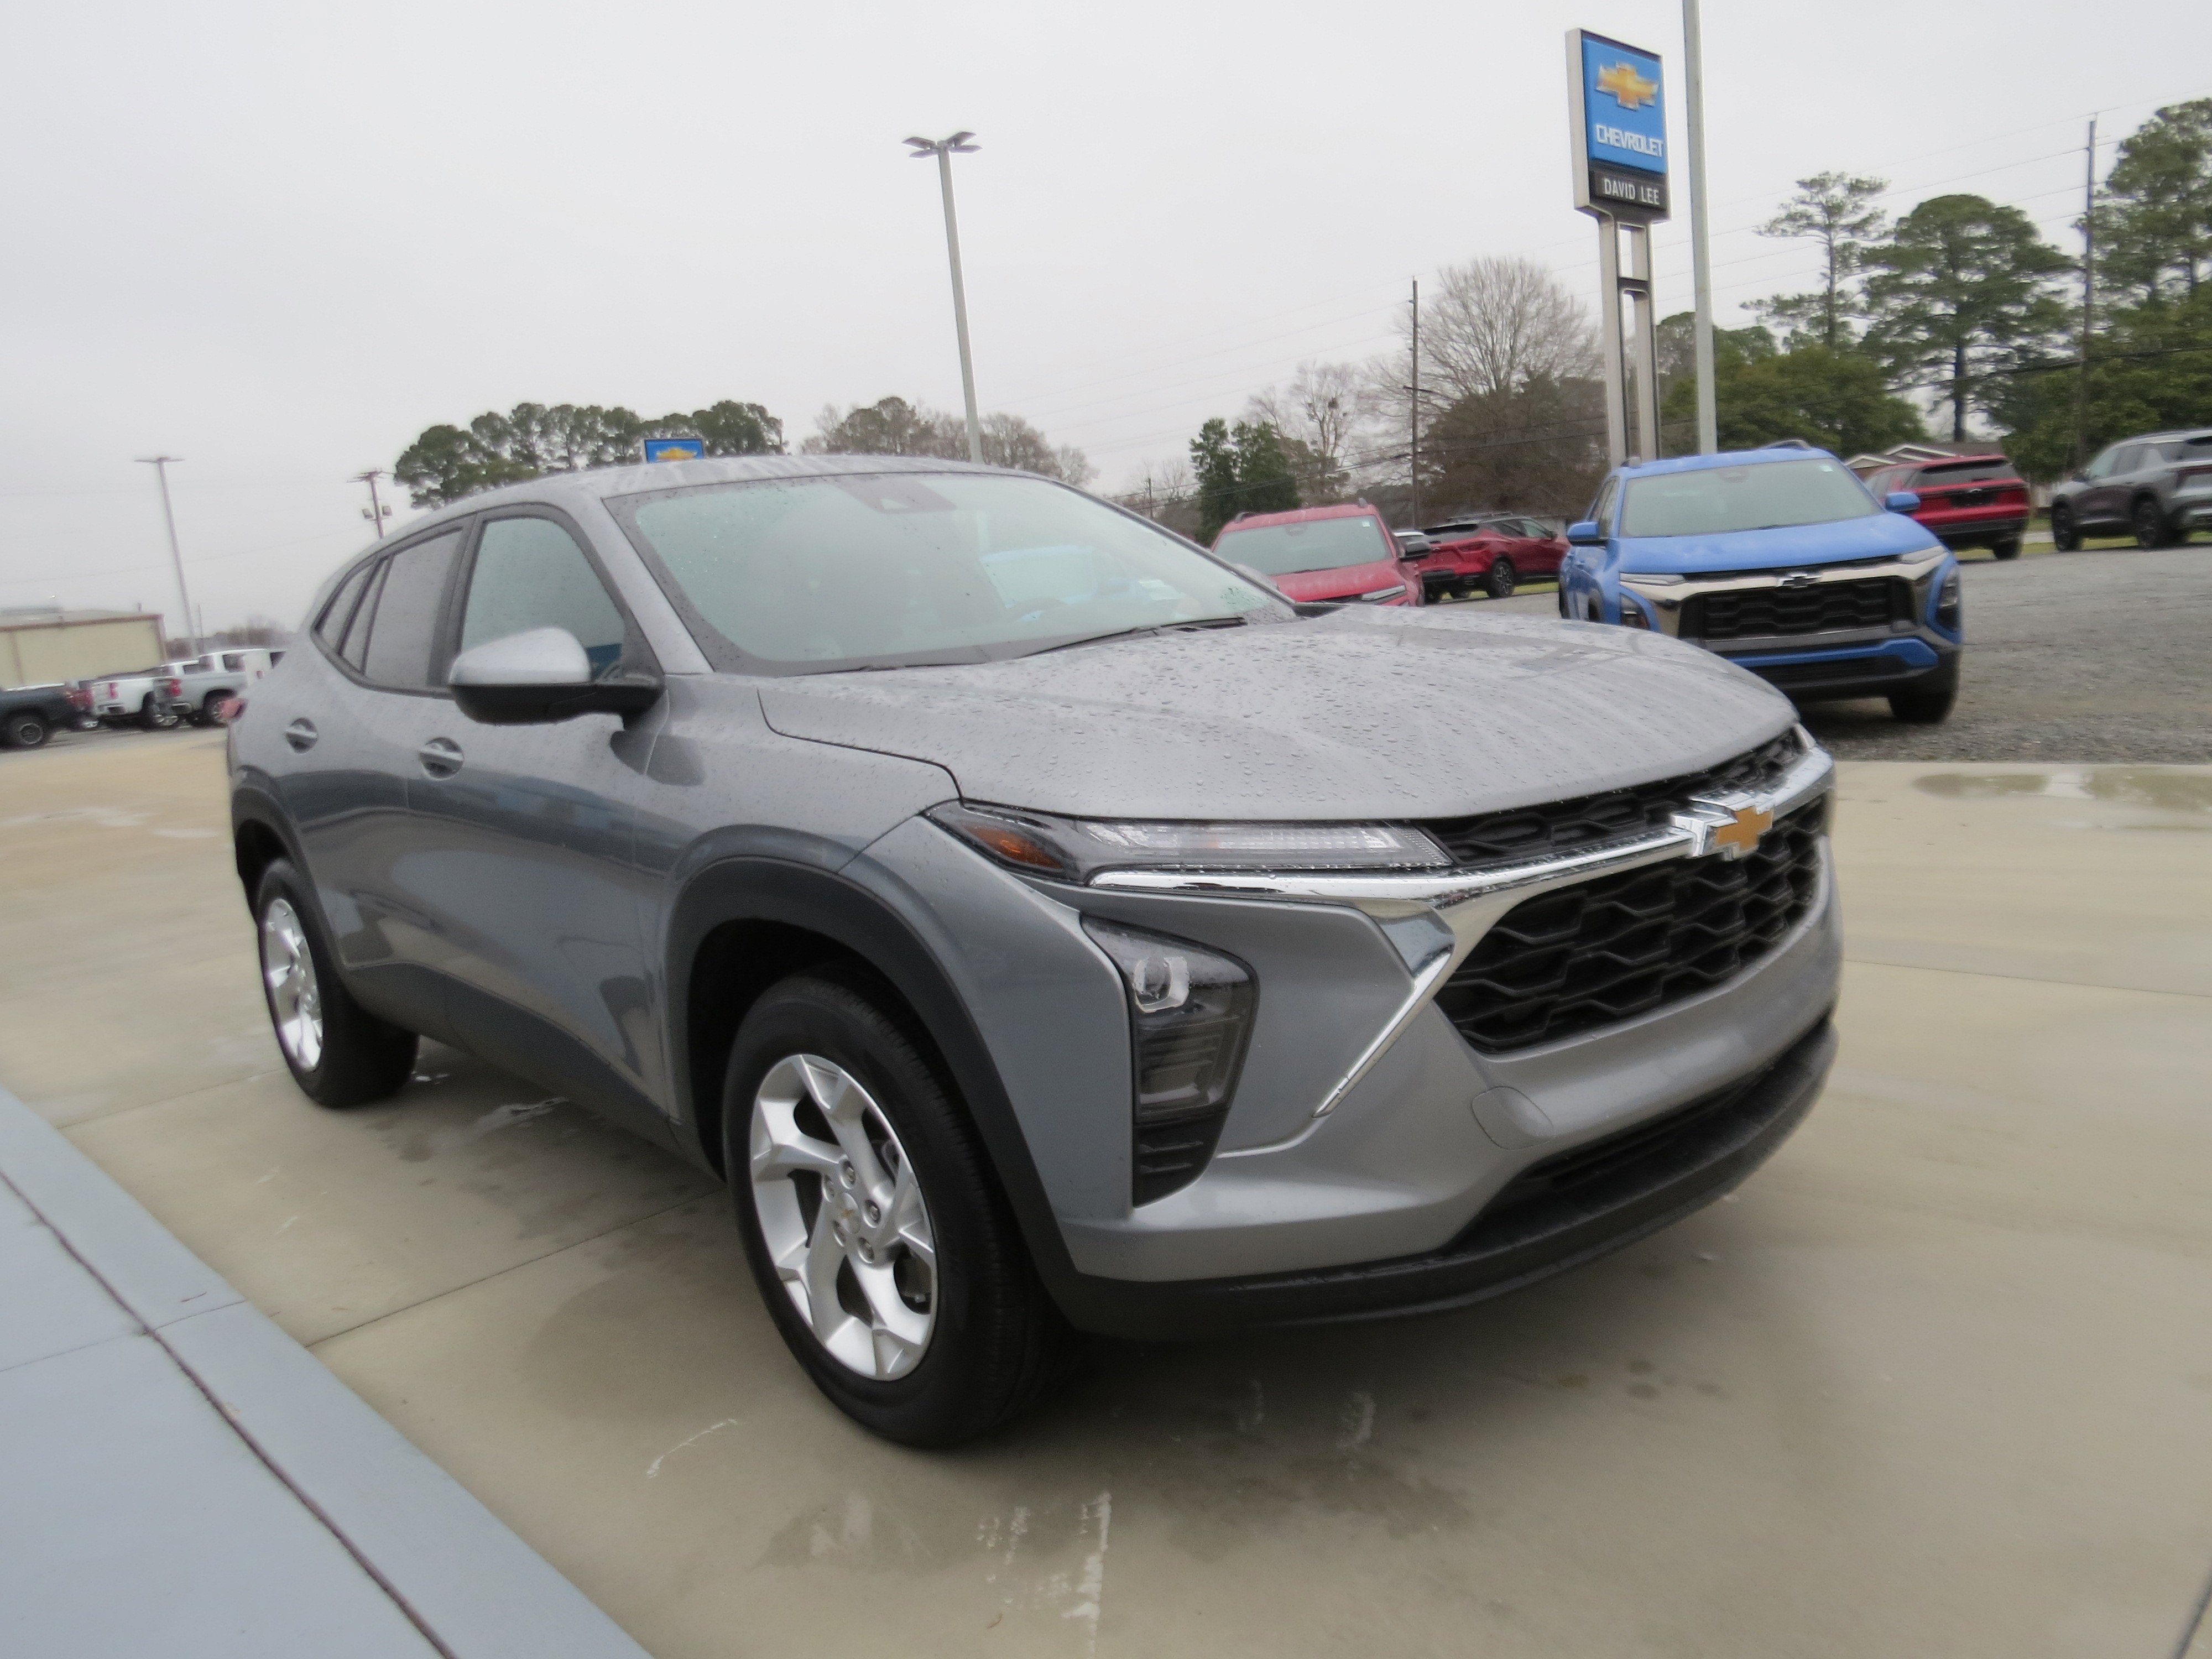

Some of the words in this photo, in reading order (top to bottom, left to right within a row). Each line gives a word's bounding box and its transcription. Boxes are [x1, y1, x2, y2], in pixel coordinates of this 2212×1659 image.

[1596, 124, 1663, 157] CHEVROLET
[1604, 178, 1635, 200] DAVID
[1641, 186, 1660, 205] LEE
